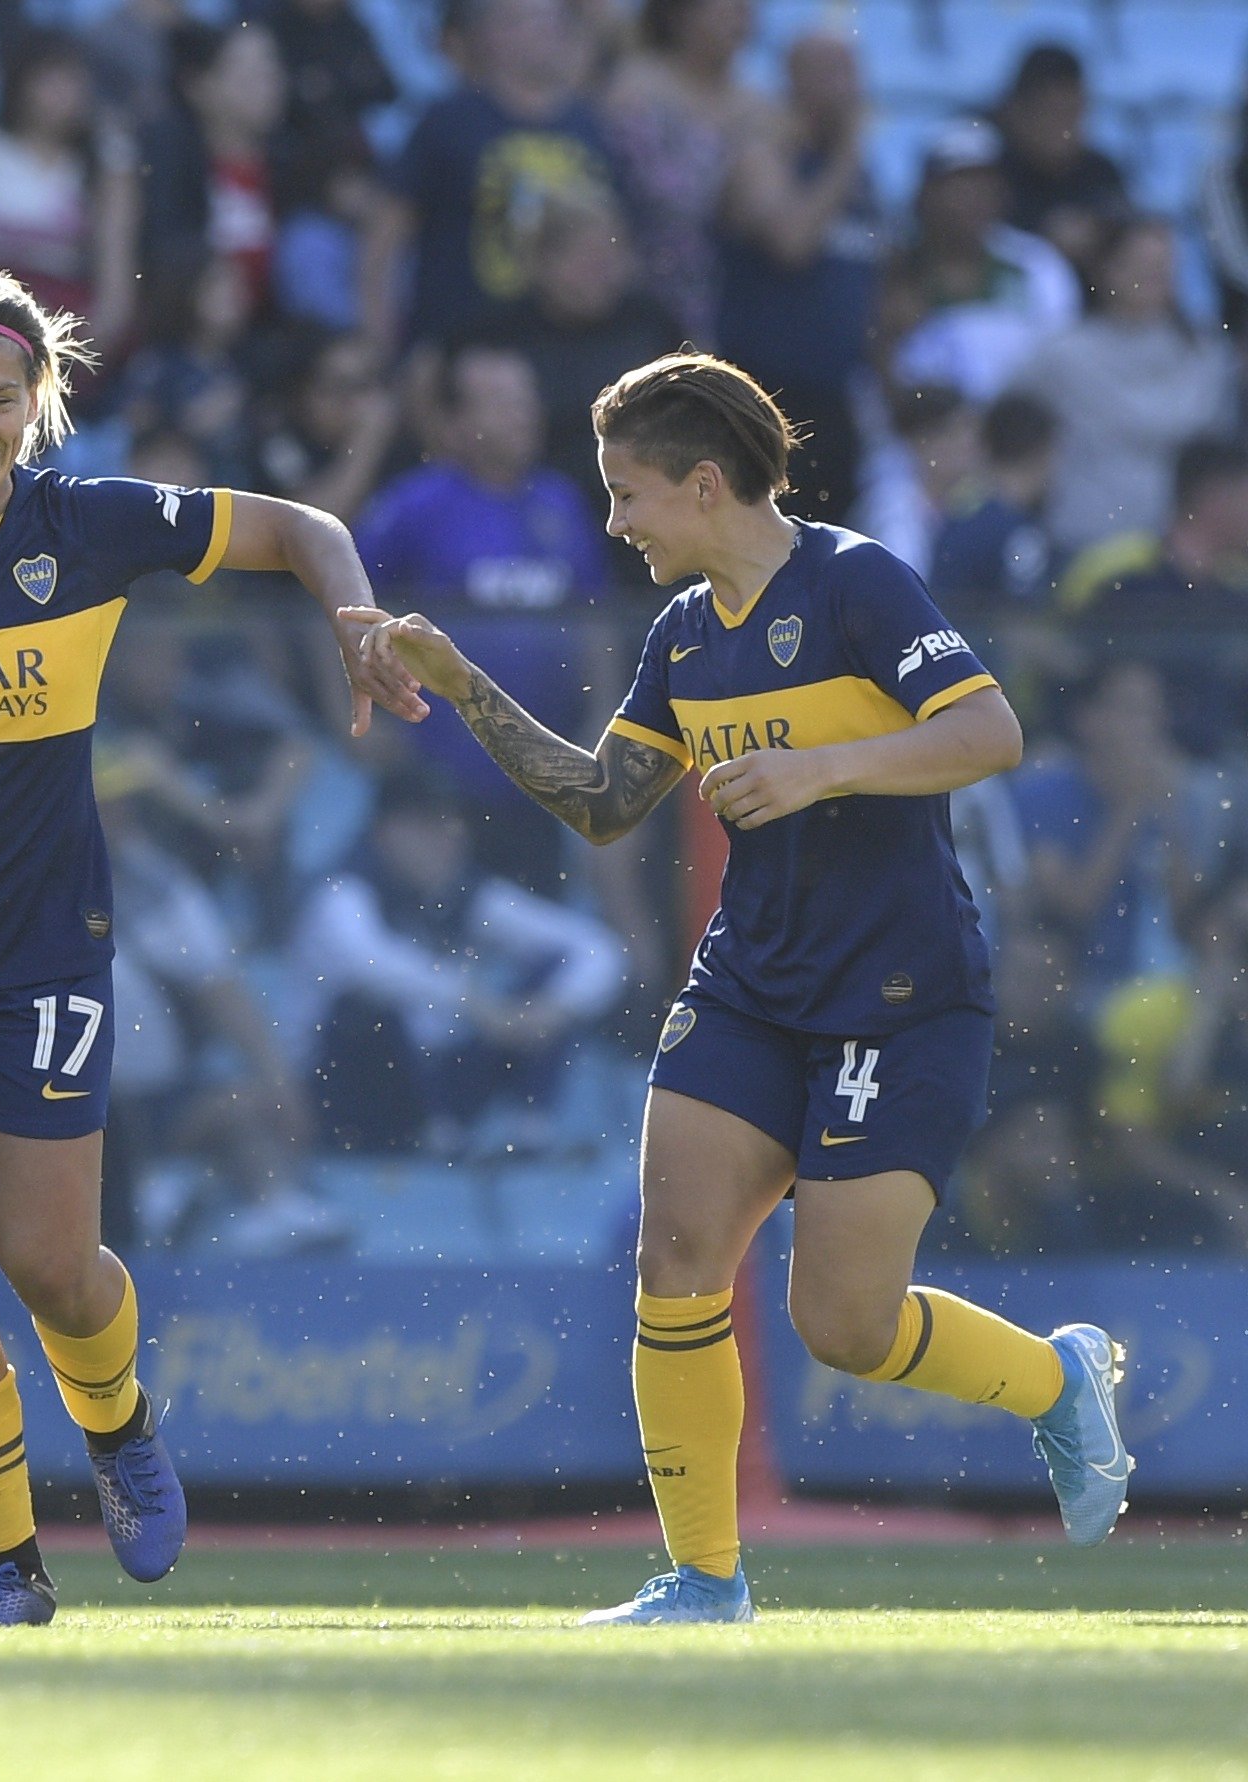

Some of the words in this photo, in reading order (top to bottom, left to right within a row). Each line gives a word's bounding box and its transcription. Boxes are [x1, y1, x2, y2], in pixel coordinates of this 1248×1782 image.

[21, 569, 52, 583] CABJ
[772, 630, 797, 644] CABJ
[32, 994, 105, 1077] 17
[834, 1039, 880, 1123] 4
